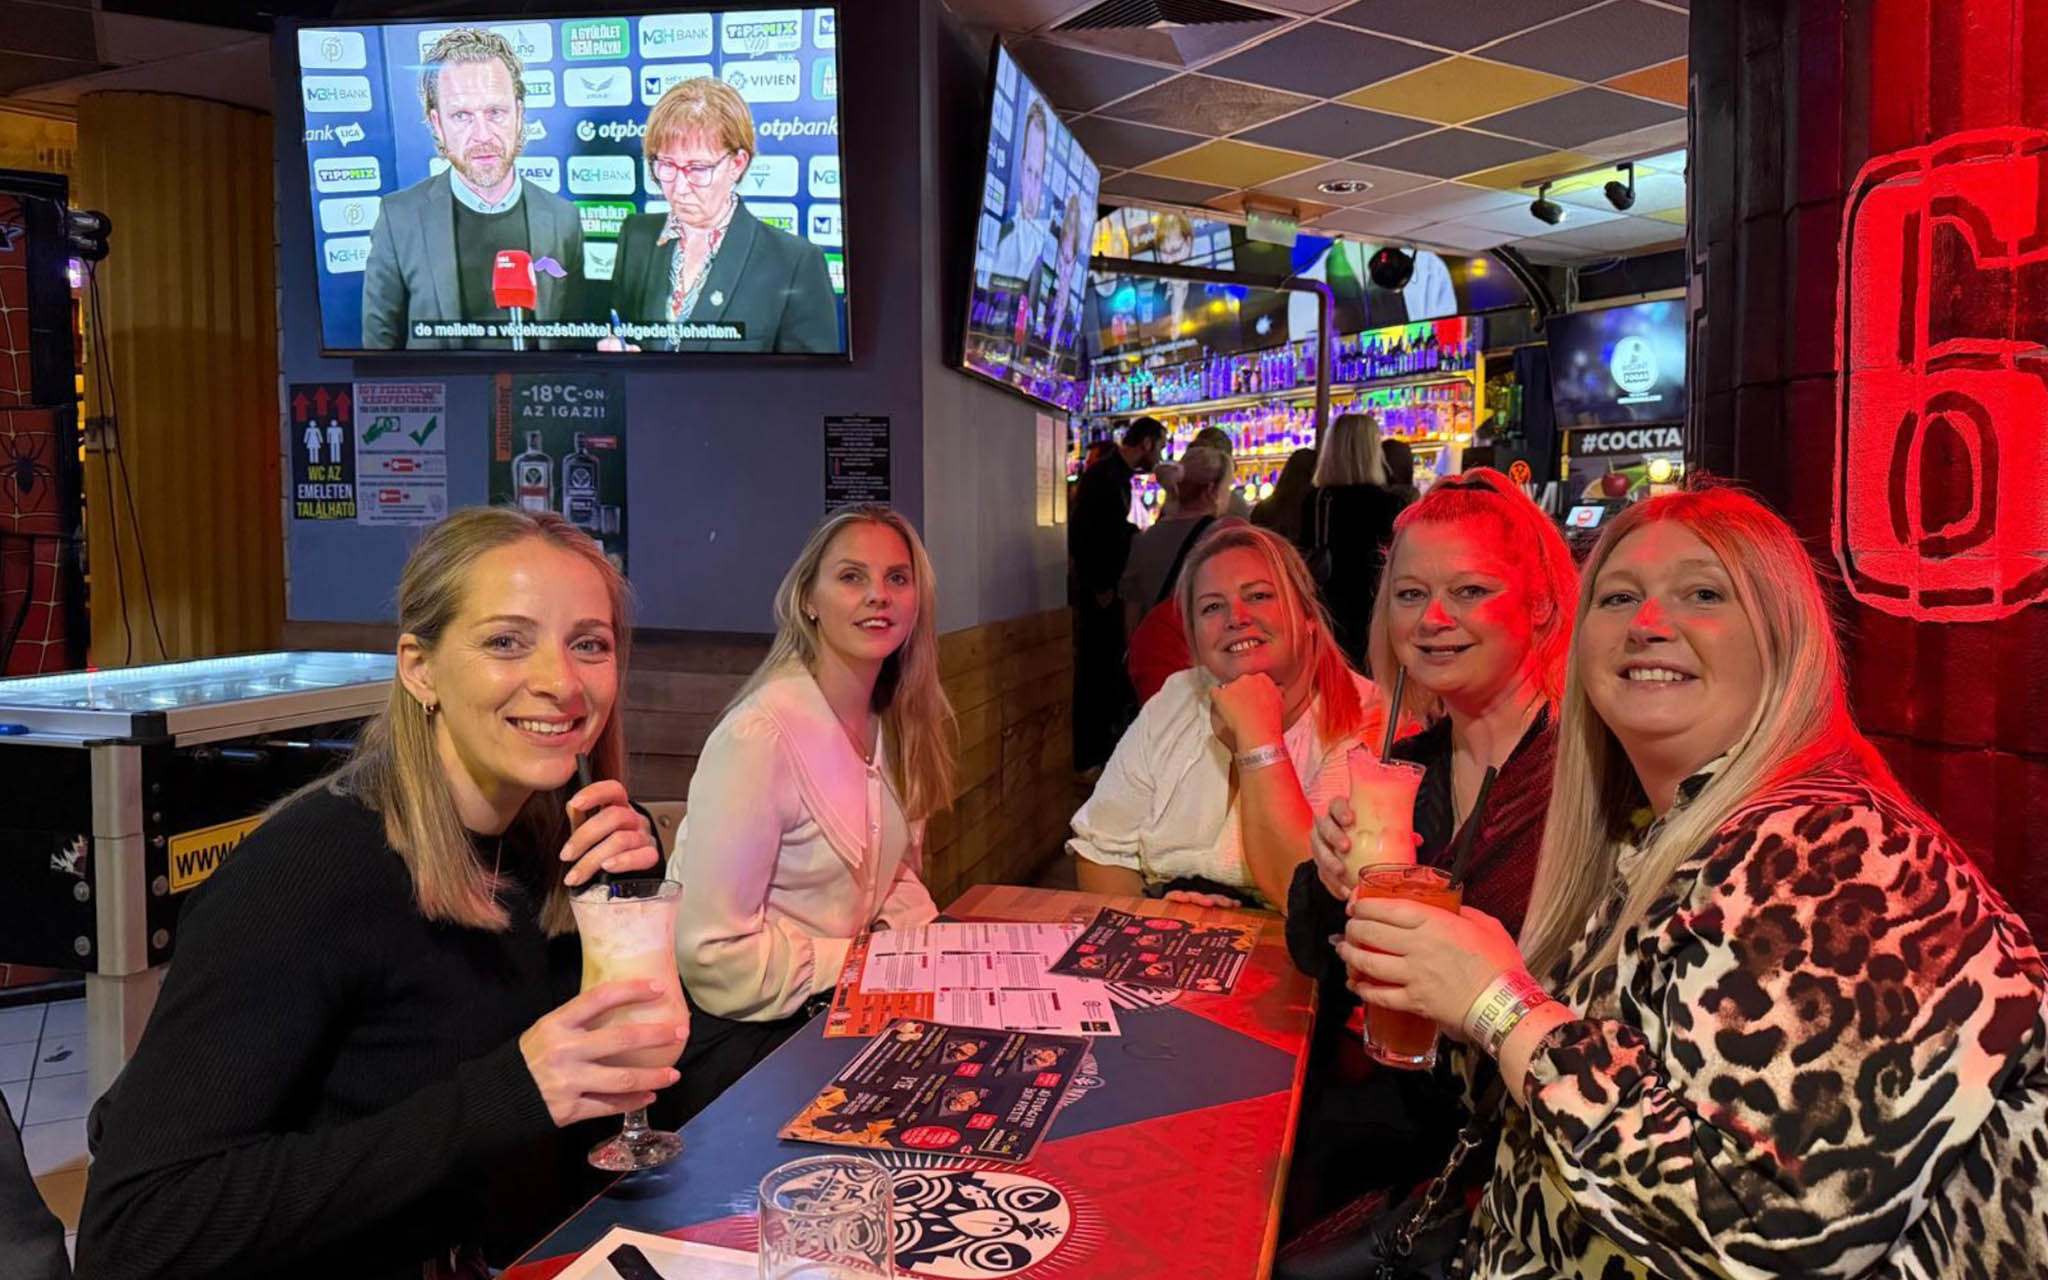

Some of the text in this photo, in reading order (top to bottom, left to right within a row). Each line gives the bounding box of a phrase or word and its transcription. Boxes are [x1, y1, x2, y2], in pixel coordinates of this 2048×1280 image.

[571, 27, 578, 40] A
[643, 28, 708, 45] MBH BANK
[751, 74, 796, 87] VIVIEN
[307, 87, 369, 101] MBH BANK
[340, 128, 361, 139] LIGA
[759, 116, 838, 141] otpbank
[572, 168, 631, 182] MBH BANK
[814, 170, 838, 185] MB
[415, 323, 432, 336] de
[435, 323, 485, 337] mellette
[487, 326, 497, 336] a
[522, 406, 606, 418] AZ IGAZI!
[1581, 427, 1683, 454] #COCKTA
[308, 466, 342, 480] WC AZ
[298, 484, 353, 499] EMELETEN
[296, 499, 355, 517] TALÁLHATÓ
